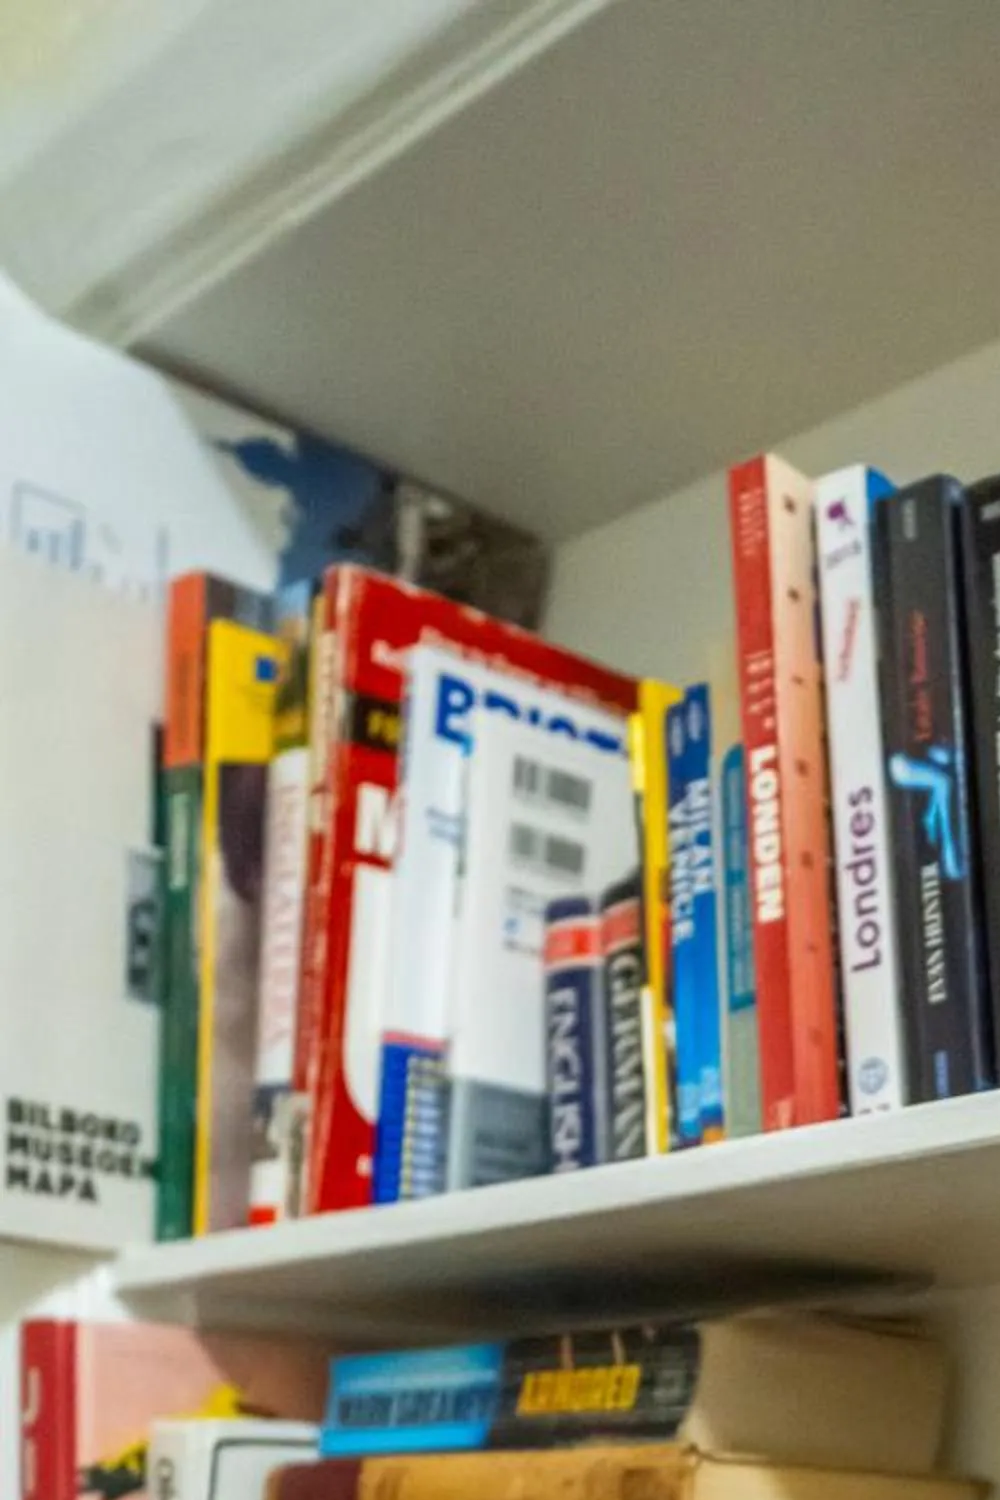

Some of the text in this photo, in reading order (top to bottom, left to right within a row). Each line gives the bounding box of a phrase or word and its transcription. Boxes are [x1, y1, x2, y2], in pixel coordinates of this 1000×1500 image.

[750, 744, 786, 924] LONDEN
[846, 785, 883, 974] Londres
[8, 1167, 98, 1202] MAPA
